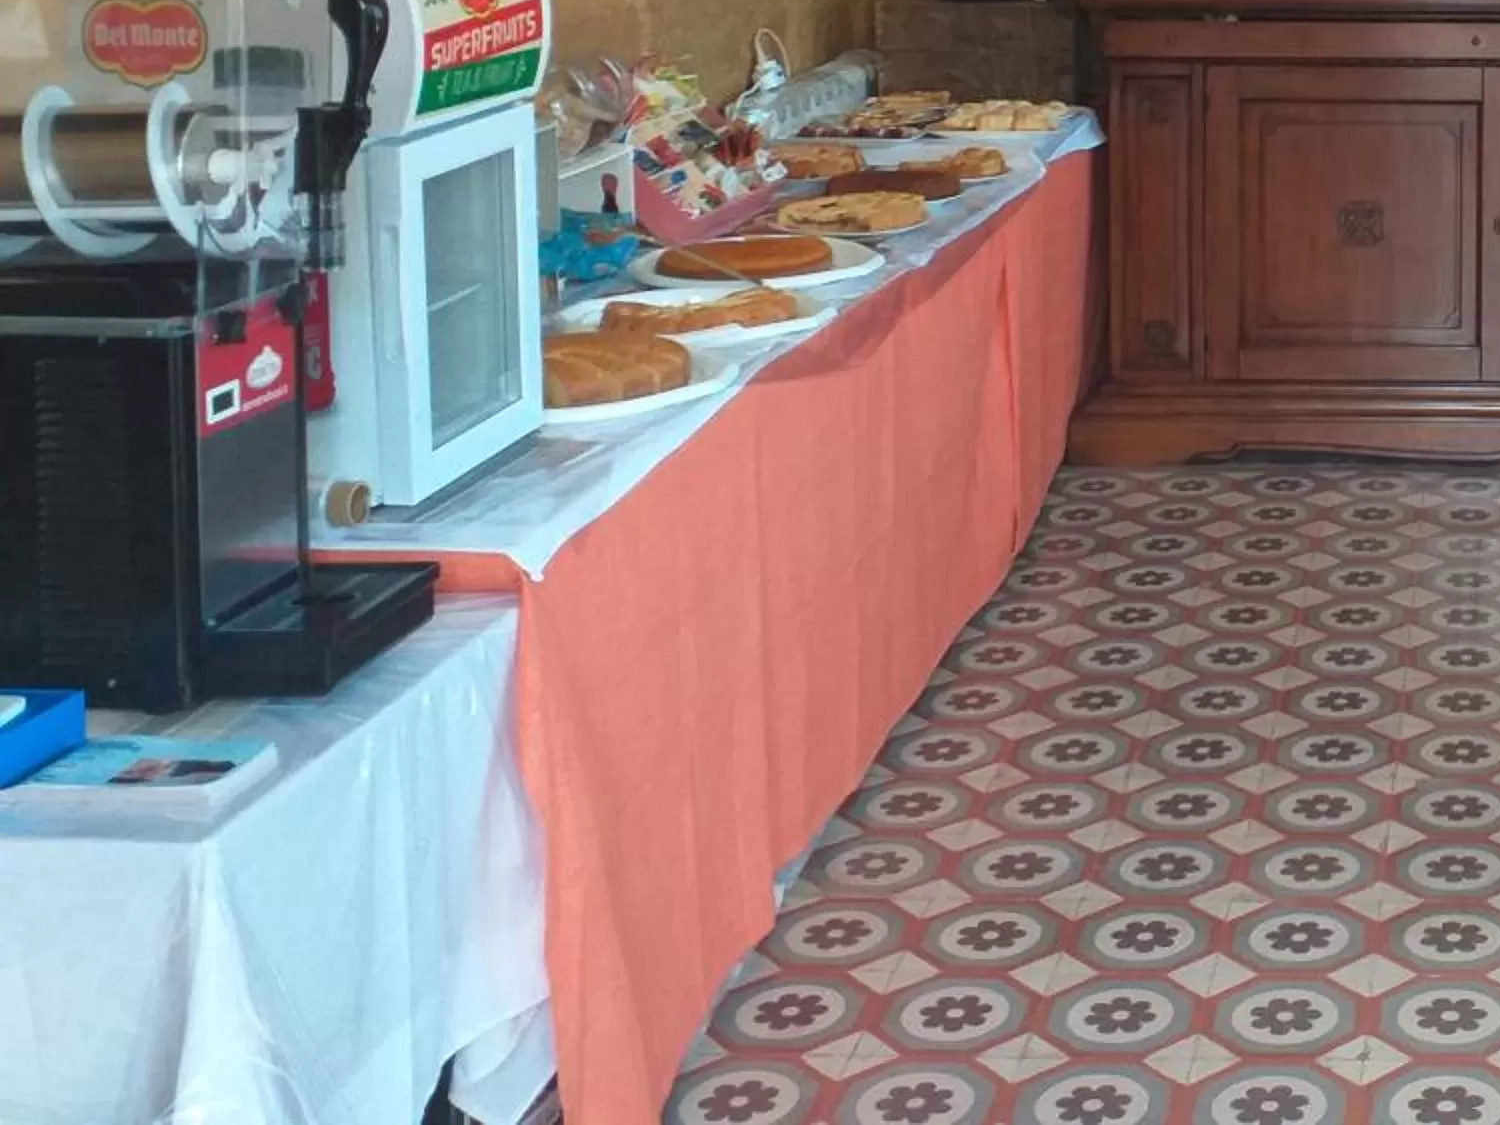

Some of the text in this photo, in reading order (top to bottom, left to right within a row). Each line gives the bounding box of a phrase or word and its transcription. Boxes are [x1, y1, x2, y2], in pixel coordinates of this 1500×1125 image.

[94, 23, 197, 47] Del Monte
[431, 10, 537, 70] SUPERFRUITS
